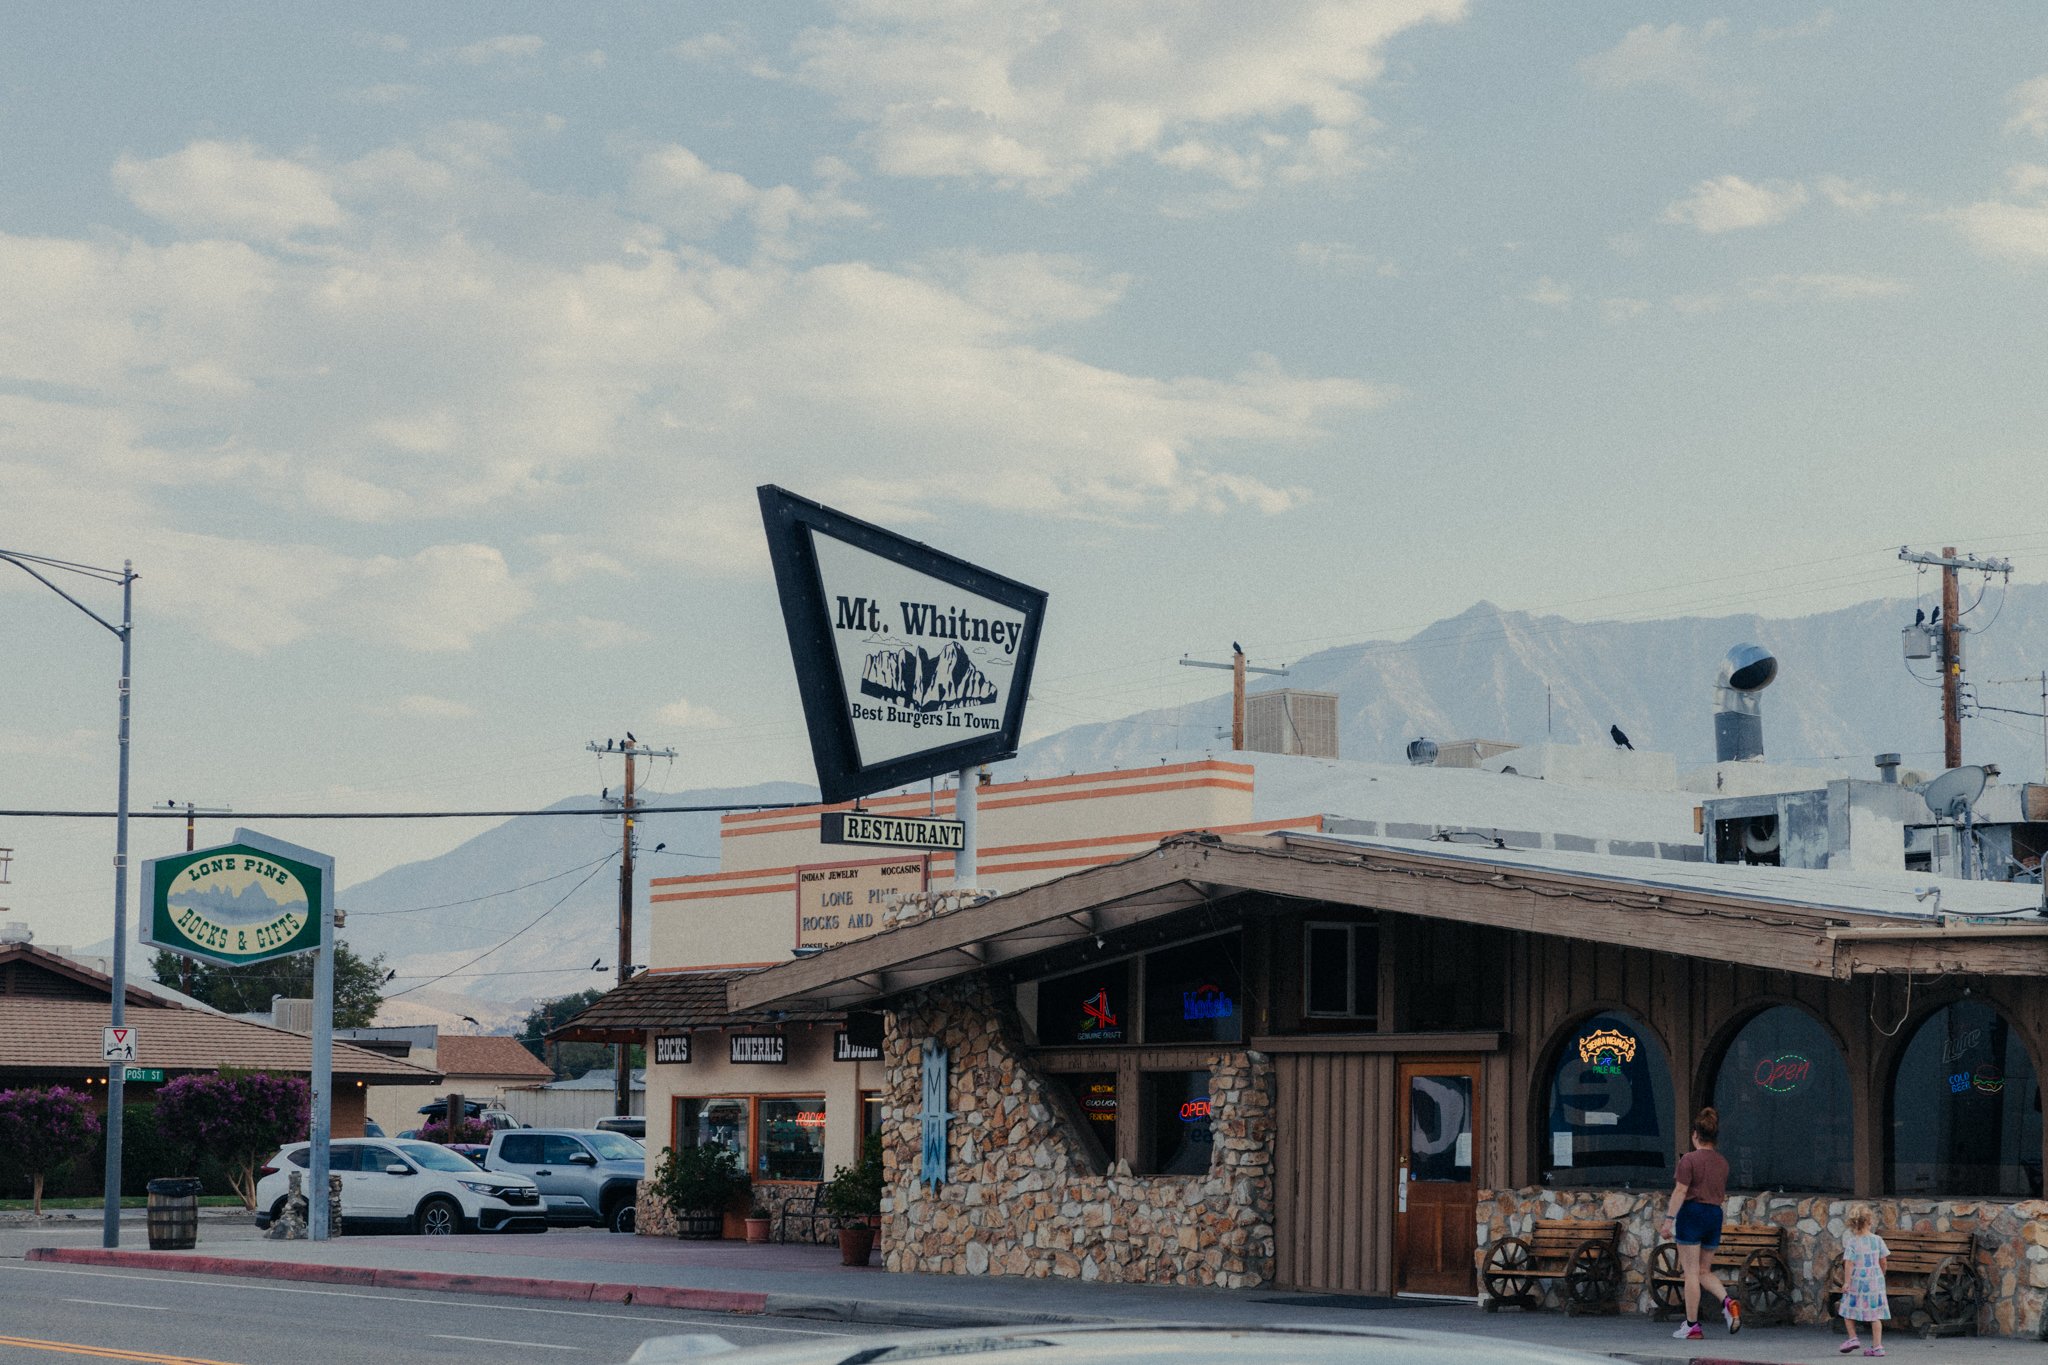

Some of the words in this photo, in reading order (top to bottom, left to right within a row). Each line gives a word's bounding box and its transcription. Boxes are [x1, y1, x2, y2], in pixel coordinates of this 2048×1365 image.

[836, 595, 890, 634] Mt.
[900, 601, 1022, 655] Whitney
[852, 702, 884, 722] Best
[886, 705, 943, 729] Burgers
[946, 711, 961, 728] In
[964, 713, 1000, 731] Town
[847, 818, 962, 846] RESTAURANT
[188, 858, 236, 882] LONE
[244, 858, 289, 886] PINE
[801, 872, 825, 882] INDIAN
[828, 869, 859, 880] JEWELRY
[880, 864, 921, 876] MOCCASINS
[821, 891, 854, 908] LONE
[177, 908, 228, 949] ROCKS
[238, 930, 248, 950] &
[257, 912, 300, 949] GIFTS
[802, 915, 840, 931] ROCKS
[848, 913, 874, 929] AND
[657, 1037, 688, 1062] ROCKS
[732, 1036, 784, 1062] MINERALS
[1586, 1037, 1606, 1051] SIERRA
[1607, 1037, 1630, 1051] NEVADA
[127, 1070, 146, 1080] POST
[151, 1071, 160, 1080] ST
[1592, 1066, 1608, 1074] PALE
[1609, 1066, 1622, 1074] ALE
[1754, 1058, 1810, 1087] Open
[1948, 1071, 1970, 1085] COLD
[1951, 1081, 1971, 1093] BEER
[1102, 1099, 1117, 1107] LIGH
[1181, 1101, 1211, 1118] OPEN
[1088, 1113, 1117, 1121] FISHERME
